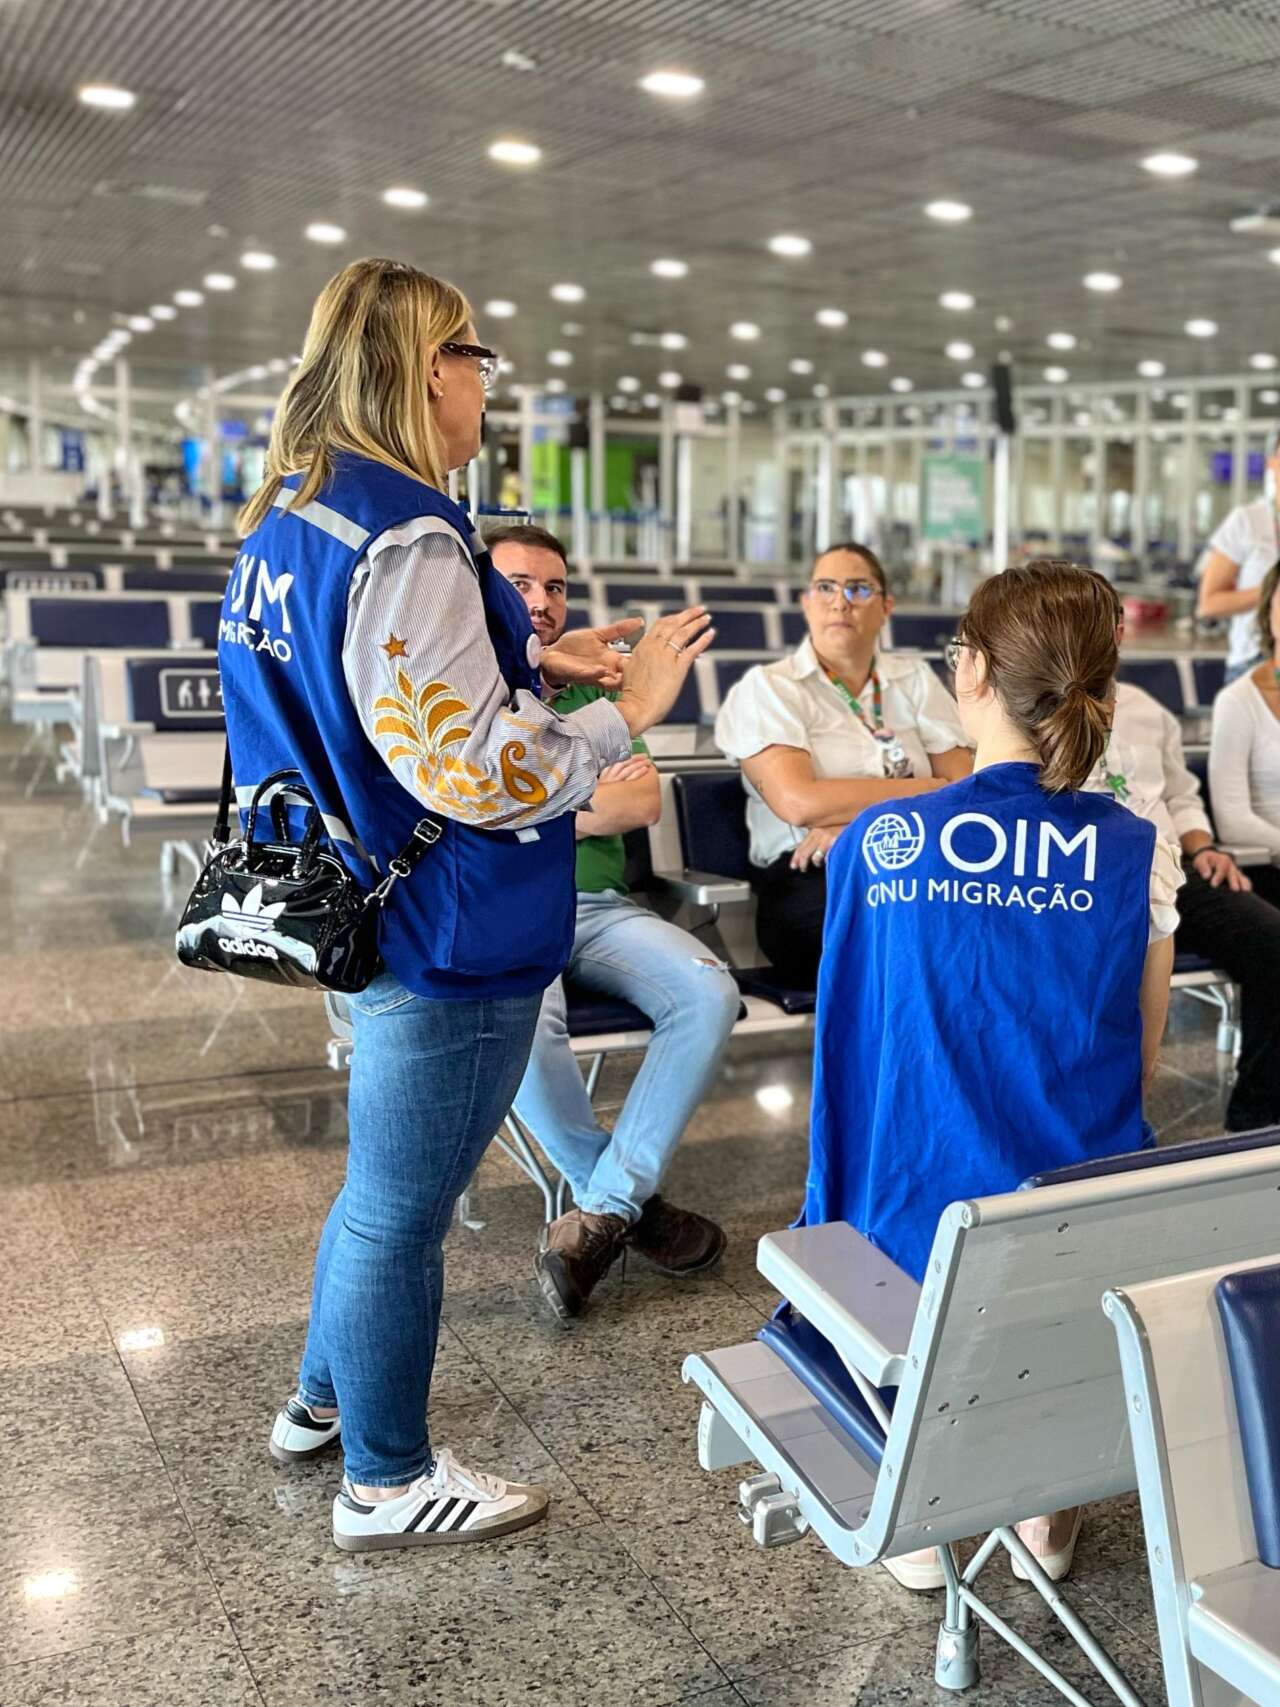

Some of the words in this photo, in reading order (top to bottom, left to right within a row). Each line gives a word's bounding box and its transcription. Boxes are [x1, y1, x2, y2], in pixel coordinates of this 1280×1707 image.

[939, 812, 1098, 882] OIM
[866, 879, 918, 908] ONU
[927, 878, 1094, 915] MIGRAÇÃO
[217, 936, 280, 961] adidas
